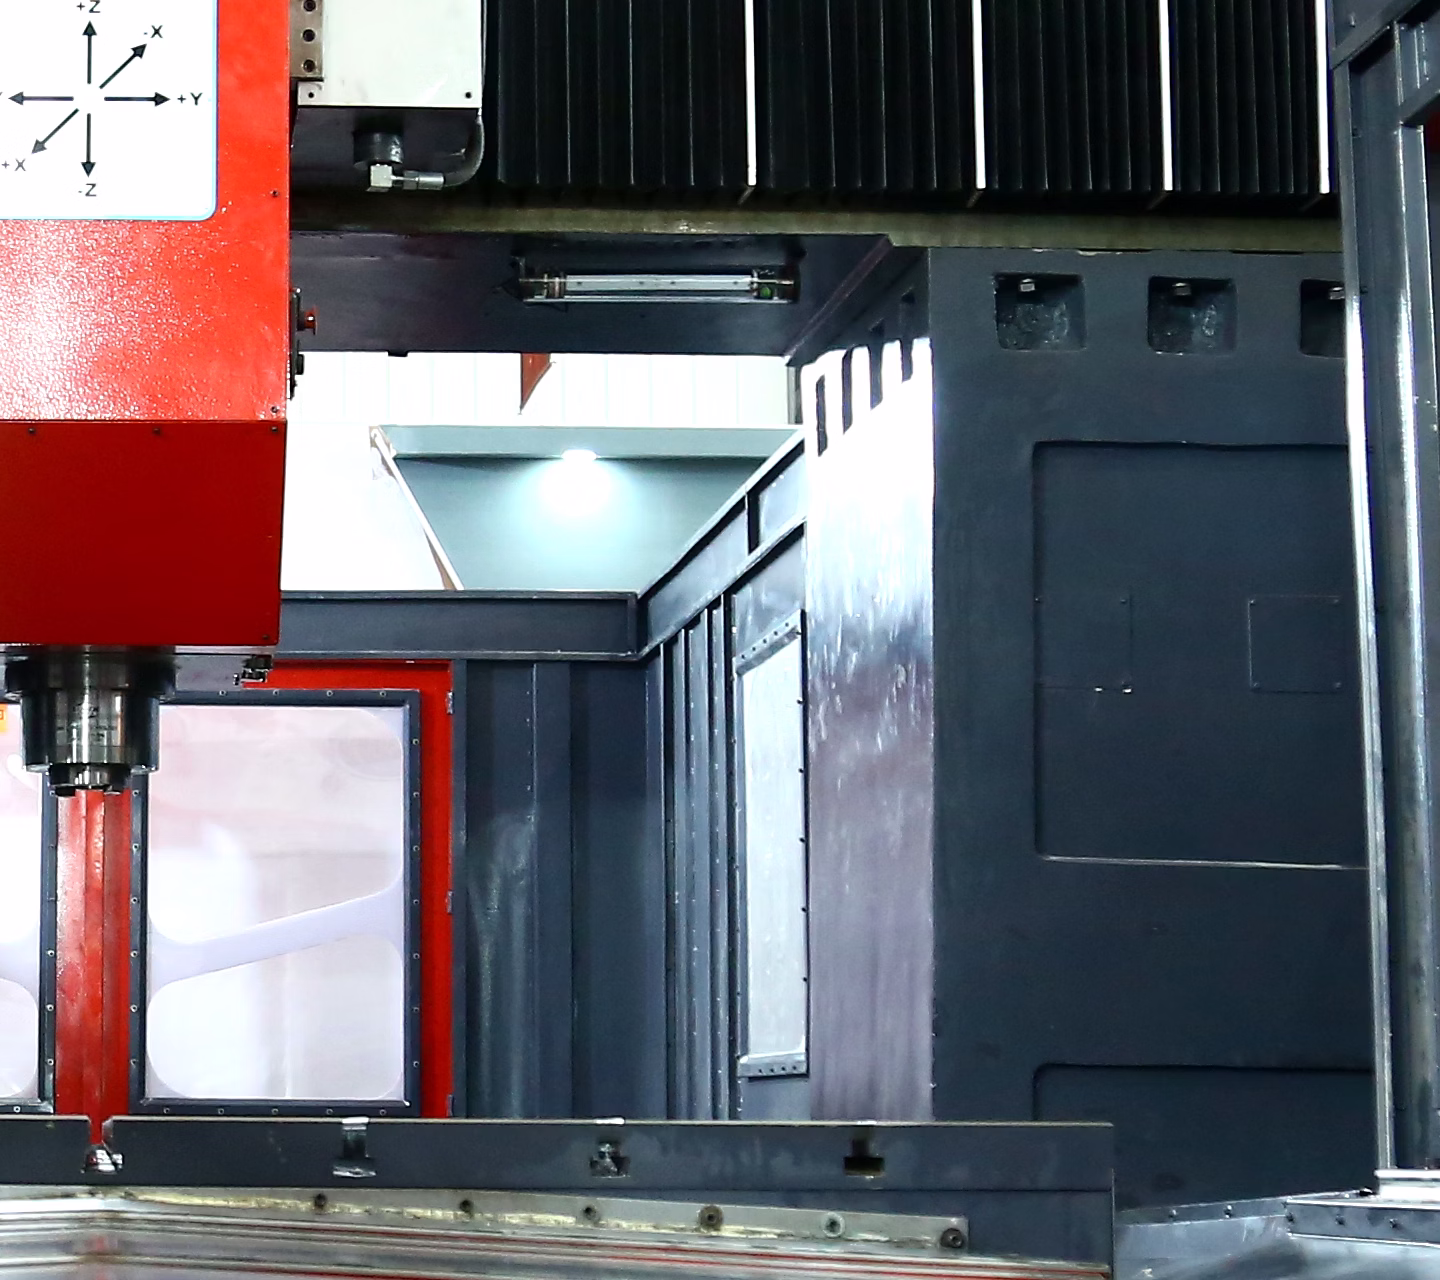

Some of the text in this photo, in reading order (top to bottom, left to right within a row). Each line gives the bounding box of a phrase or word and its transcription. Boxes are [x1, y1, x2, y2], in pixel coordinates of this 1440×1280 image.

[76, 0, 101, 14] +Z
[143, 24, 164, 39] -X
[176, 92, 203, 106] +Y
[1, 158, 26, 172] +X
[77, 182, 97, 197] -Z
